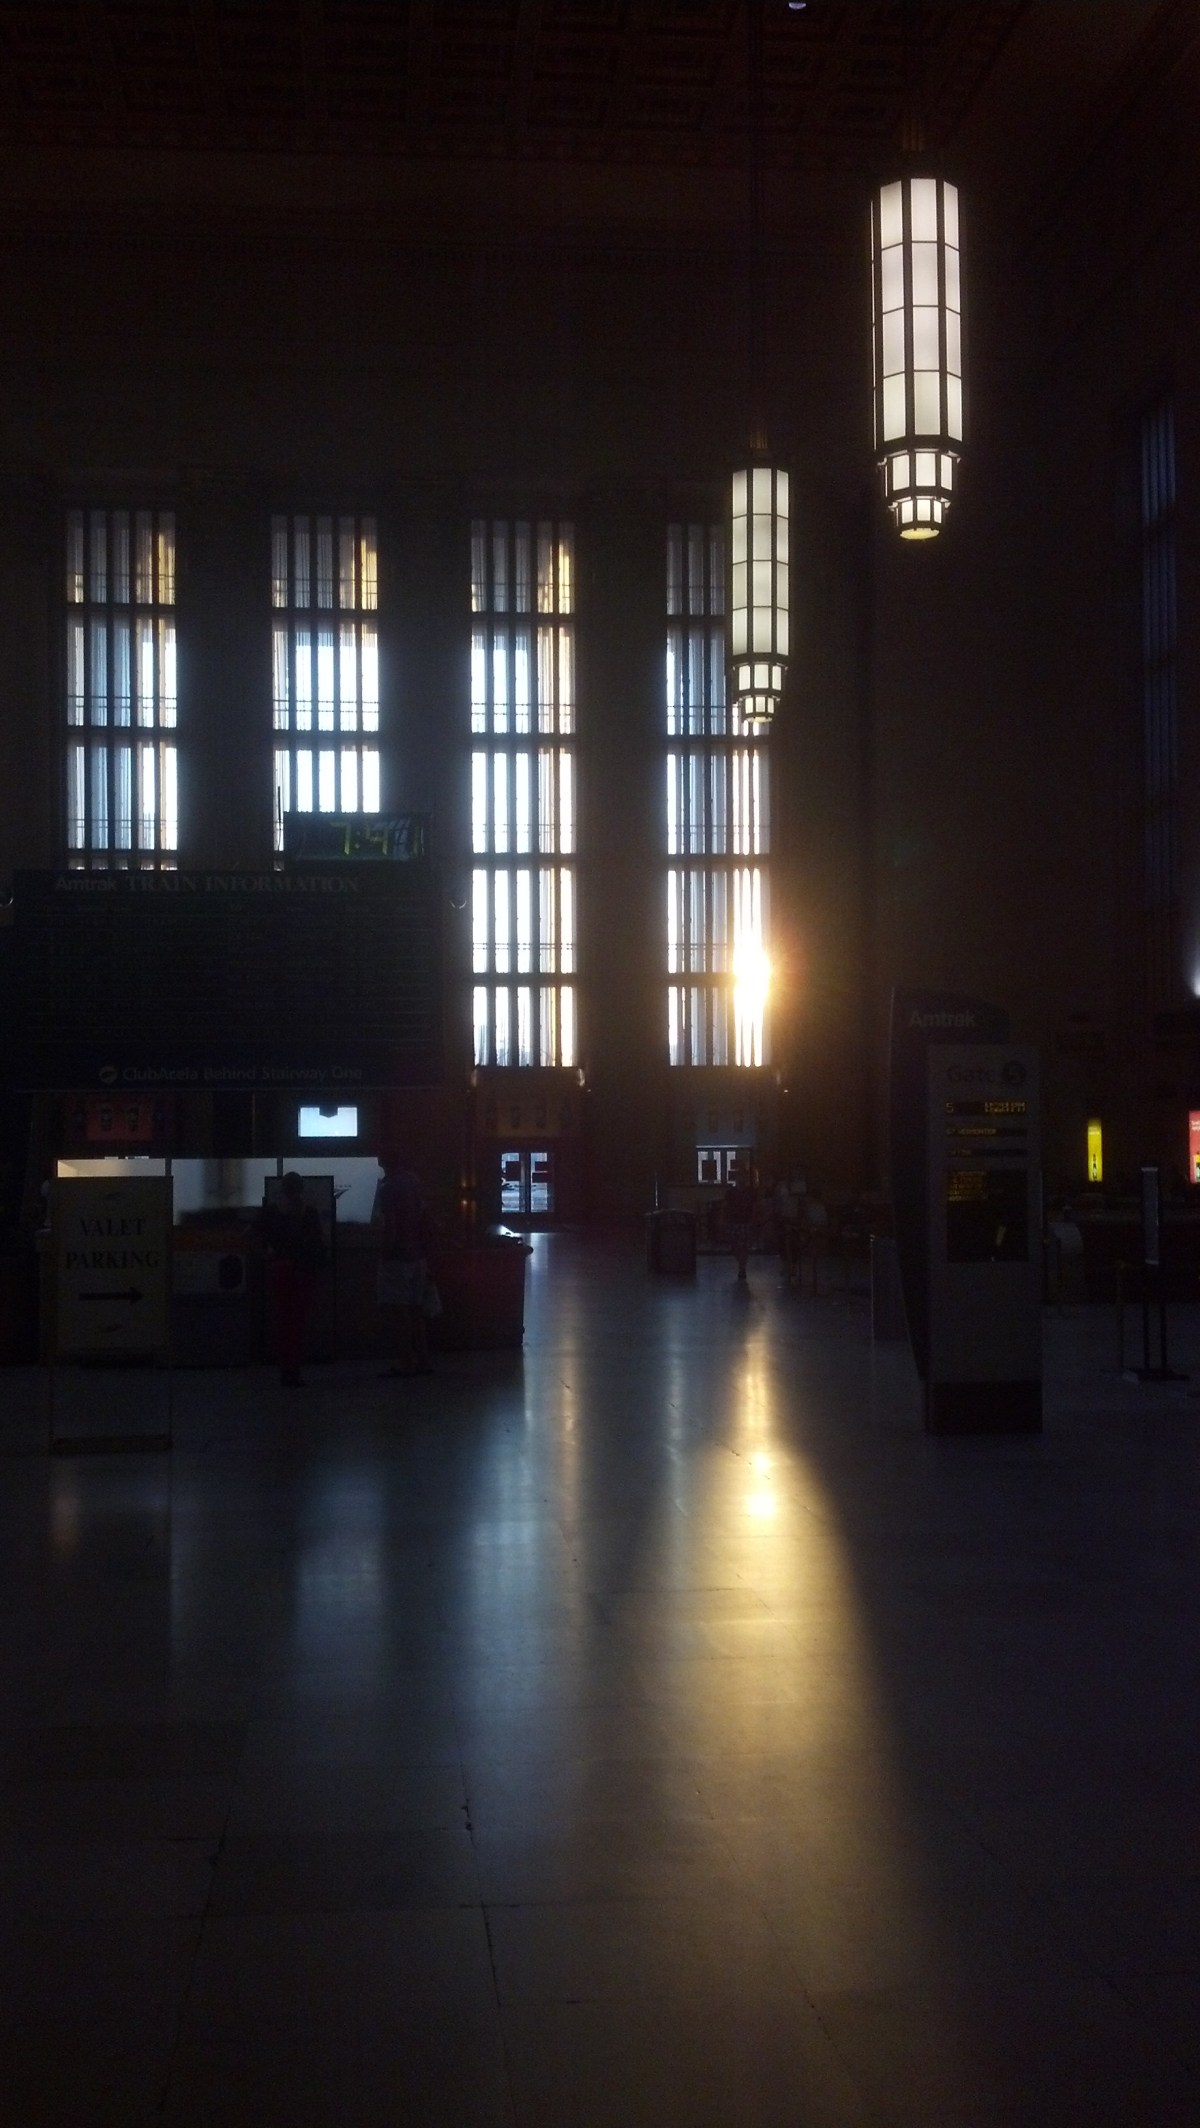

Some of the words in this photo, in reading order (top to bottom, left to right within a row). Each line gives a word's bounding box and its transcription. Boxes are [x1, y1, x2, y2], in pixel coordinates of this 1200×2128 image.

[55, 876, 118, 891] Amtrak
[126, 876, 200, 891] TRAIN
[205, 876, 359, 891] INFORMATION
[909, 1010, 976, 1028] Amtrak
[122, 1066, 199, 1081] ClubAcela
[203, 1066, 257, 1081] Behind
[261, 1066, 328, 1084] Stairway
[332, 1066, 363, 1081] One
[946, 1064, 996, 1083] Gate
[79, 1218, 147, 1236] VALET
[65, 1250, 160, 1270] PARKING
